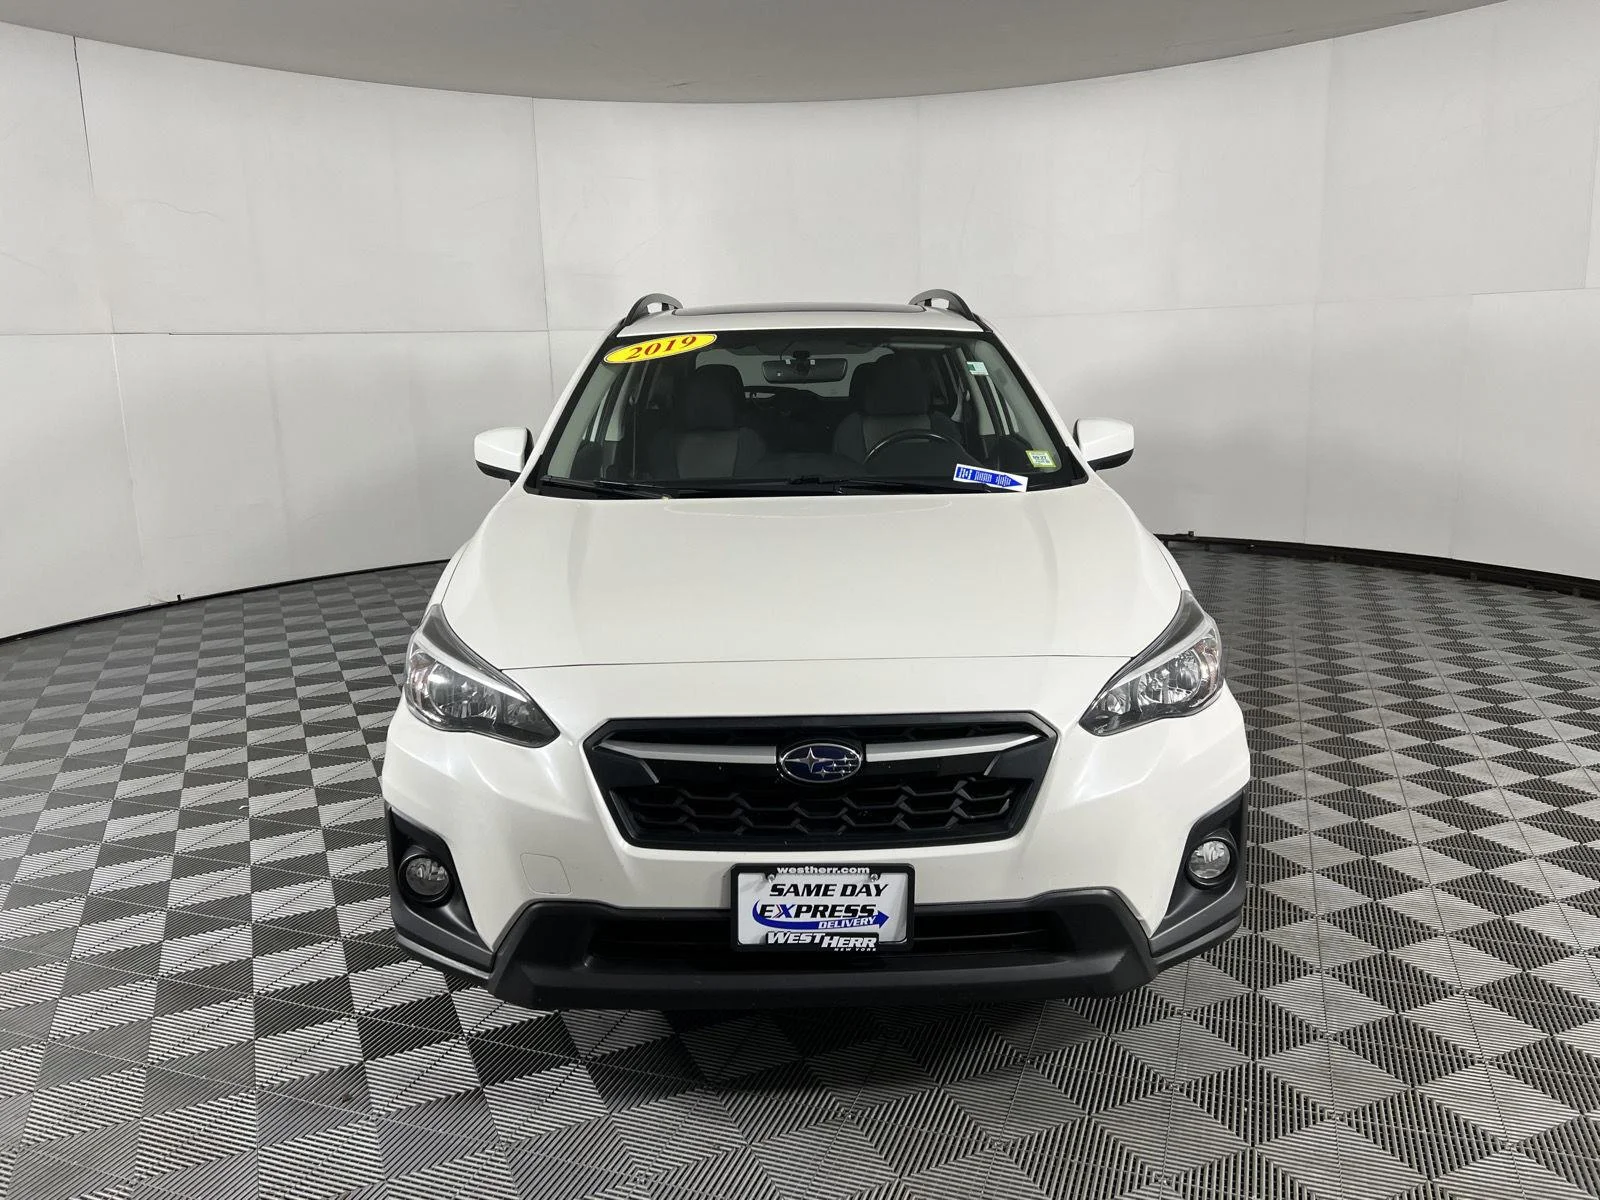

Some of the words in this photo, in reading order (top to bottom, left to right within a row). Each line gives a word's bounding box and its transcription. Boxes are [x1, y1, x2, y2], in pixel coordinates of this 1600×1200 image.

[625, 336, 697, 360] 2019
[776, 866, 870, 874] westherr.com
[769, 883, 838, 897] SAME
[840, 883, 889, 897] DAY
[758, 904, 877, 919] EXPRESS
[818, 916, 877, 929] DELIVERY
